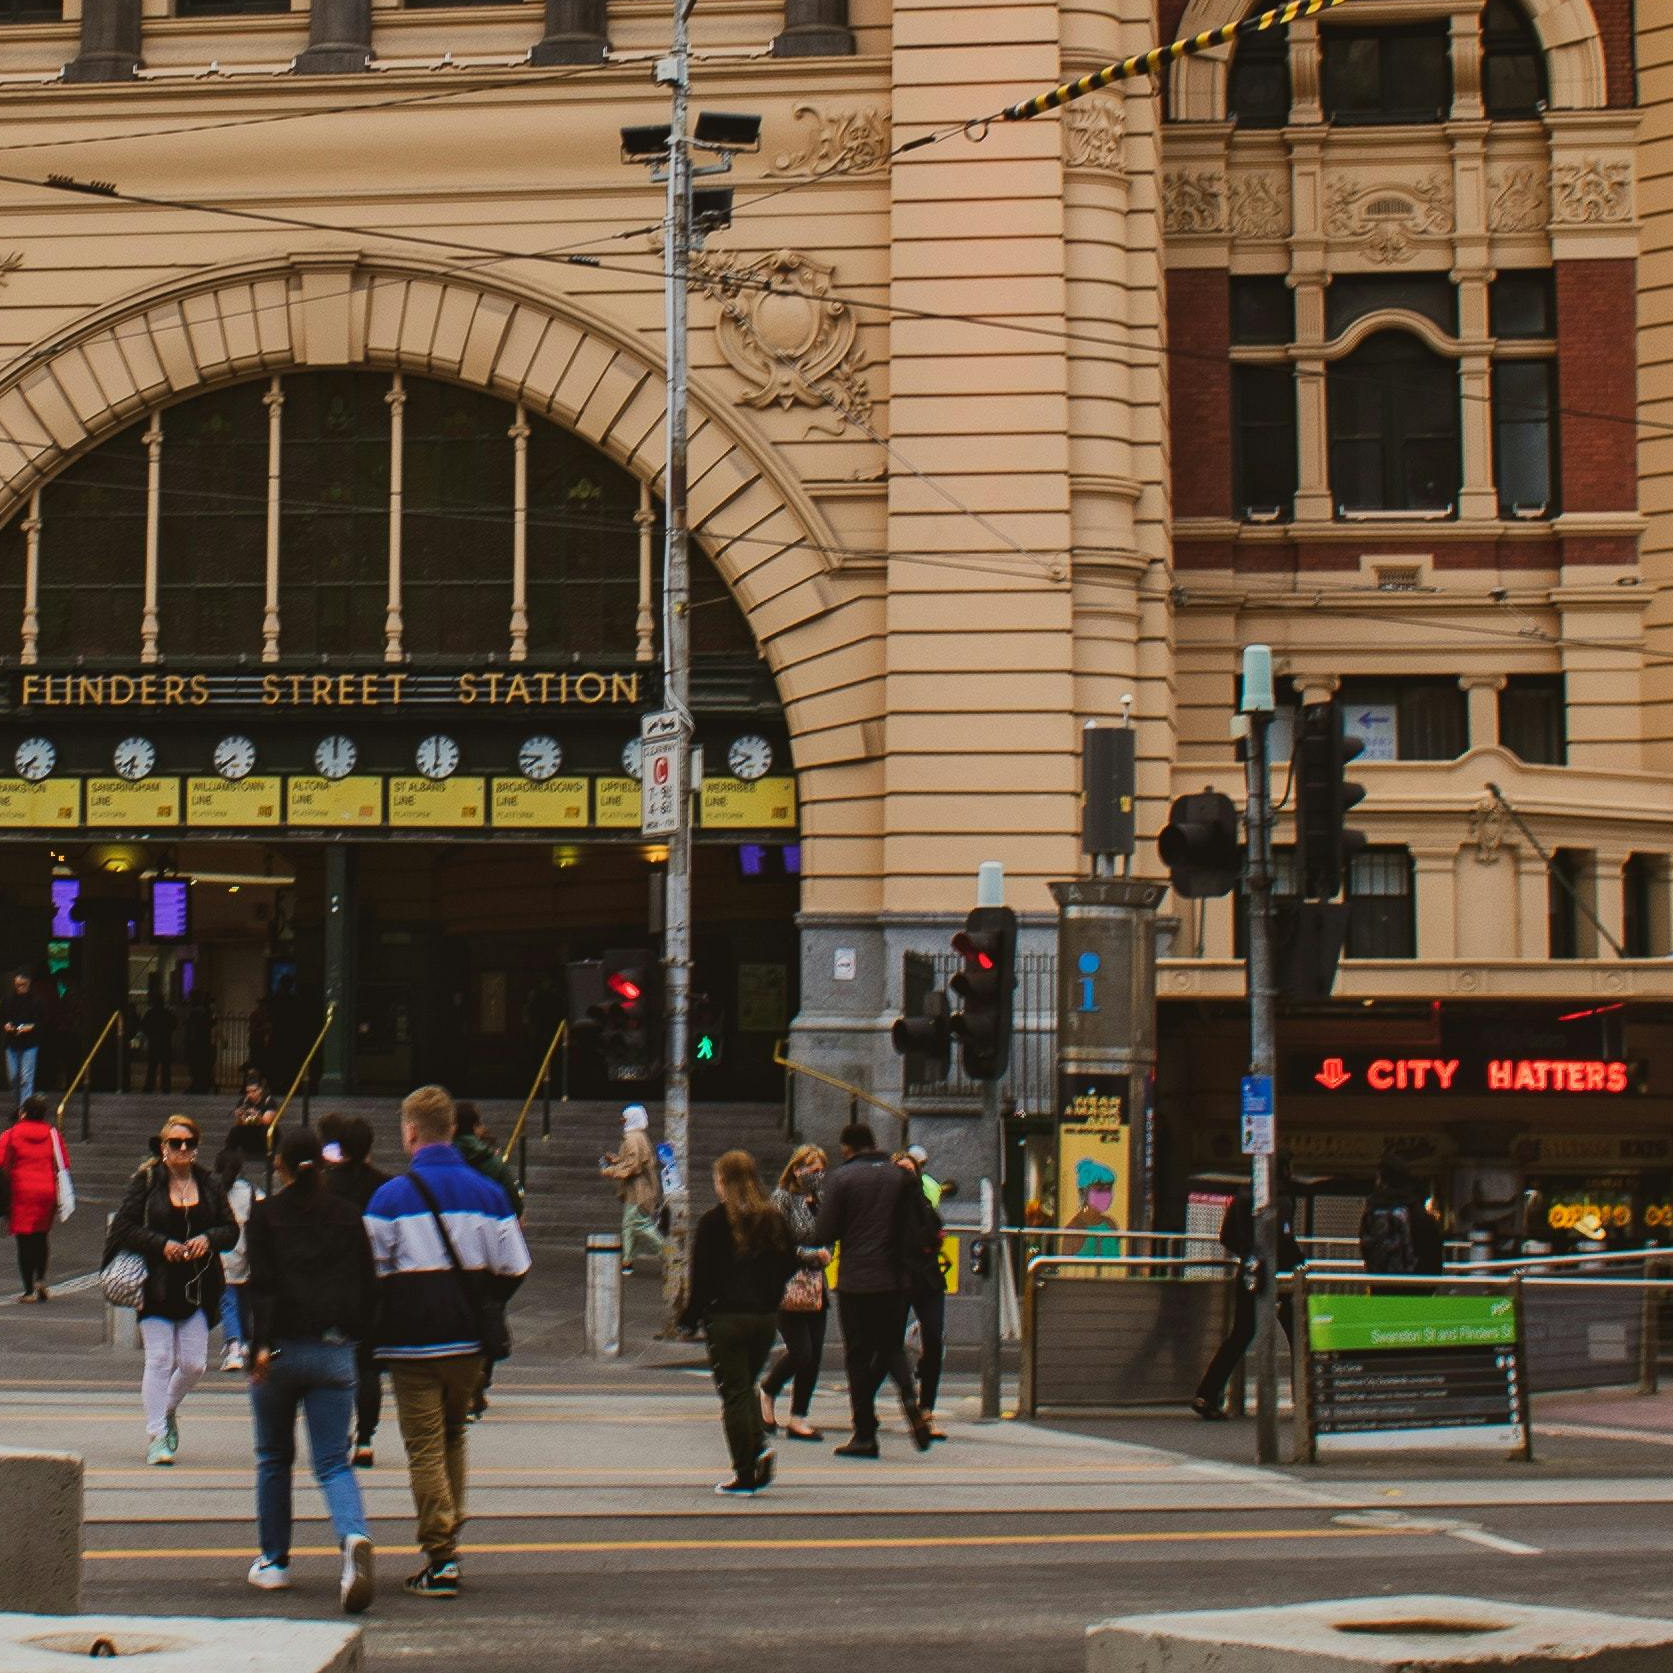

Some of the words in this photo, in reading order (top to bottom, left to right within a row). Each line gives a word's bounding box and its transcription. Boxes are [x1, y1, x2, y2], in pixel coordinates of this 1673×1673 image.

[21, 674, 211, 706] FLINDERS
[261, 673, 408, 706] STREET
[457, 672, 640, 705] STATION
[393, 782, 405, 793] ST
[407, 782, 447, 793] ALBANS
[90, 795, 113, 807] LINE
[191, 795, 214, 806] LINE
[291, 794, 313, 805] LINE
[393, 795, 416, 807] LINE
[496, 795, 519, 807] LINE
[600, 795, 624, 807] LINE
[705, 796, 729, 807] LINE
[1367, 1059, 1460, 1091] CITY
[1487, 1059, 1628, 1093] HATTERS
